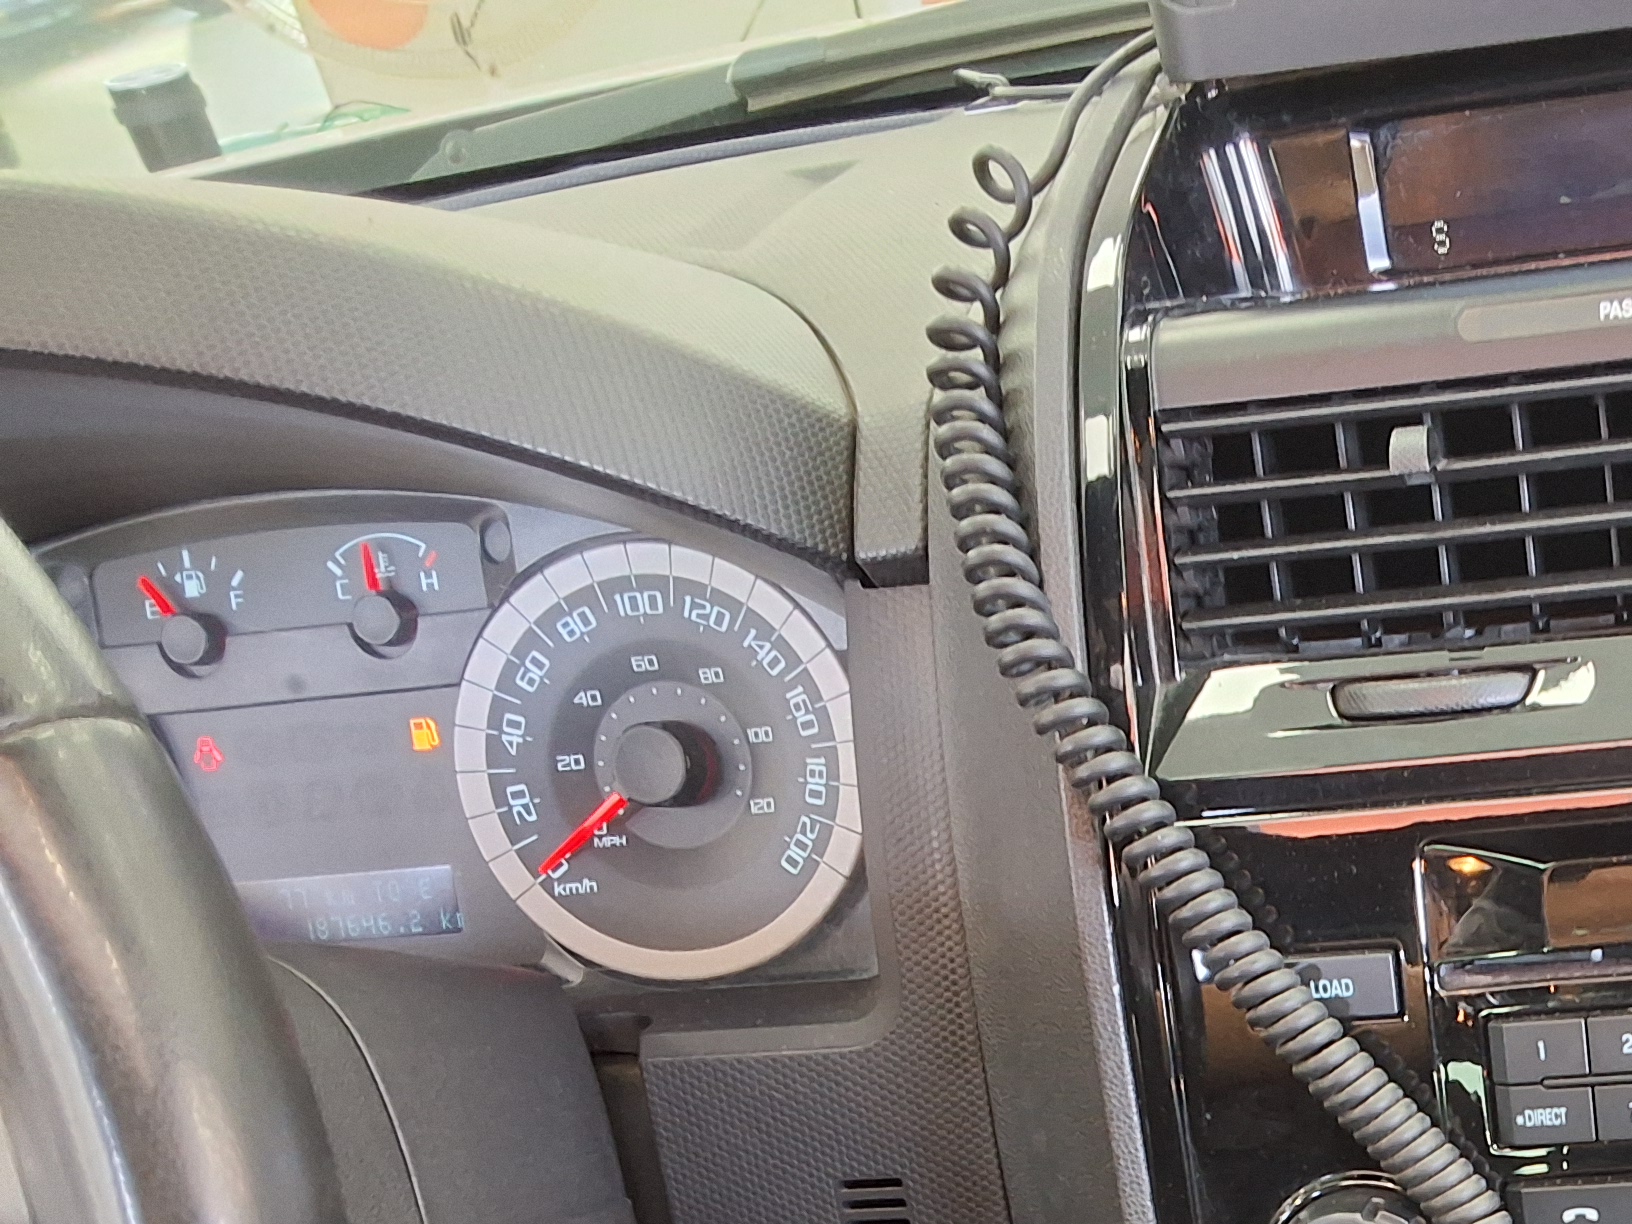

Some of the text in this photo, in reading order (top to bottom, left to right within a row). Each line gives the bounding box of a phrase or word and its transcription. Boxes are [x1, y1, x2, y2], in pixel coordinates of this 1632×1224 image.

[336, 579, 352, 600] C
[420, 570, 439, 592] H
[230, 590, 244, 611] F
[613, 590, 664, 617] 100
[556, 606, 597, 642] 80
[683, 595, 730, 633] 120
[742, 628, 786, 677] 140
[515, 650, 550, 693] 60
[630, 654, 660, 673] 60
[698, 667, 724, 684] 80
[573, 689, 602, 707] 40
[785, 684, 819, 737] 160
[501, 712, 526, 756] 40
[746, 725, 773, 744] 100
[556, 753, 586, 772] 20
[805, 756, 827, 806] 180
[506, 783, 538, 825] 20
[749, 797, 775, 815] 120
[593, 835, 627, 849] MPH
[780, 814, 820, 875] 200
[554, 878, 598, 897] km/h
[1310, 978, 1354, 999] LOAD
[1537, 1040, 1546, 1061] 1
[1523, 1106, 1567, 1126] DIRECT
